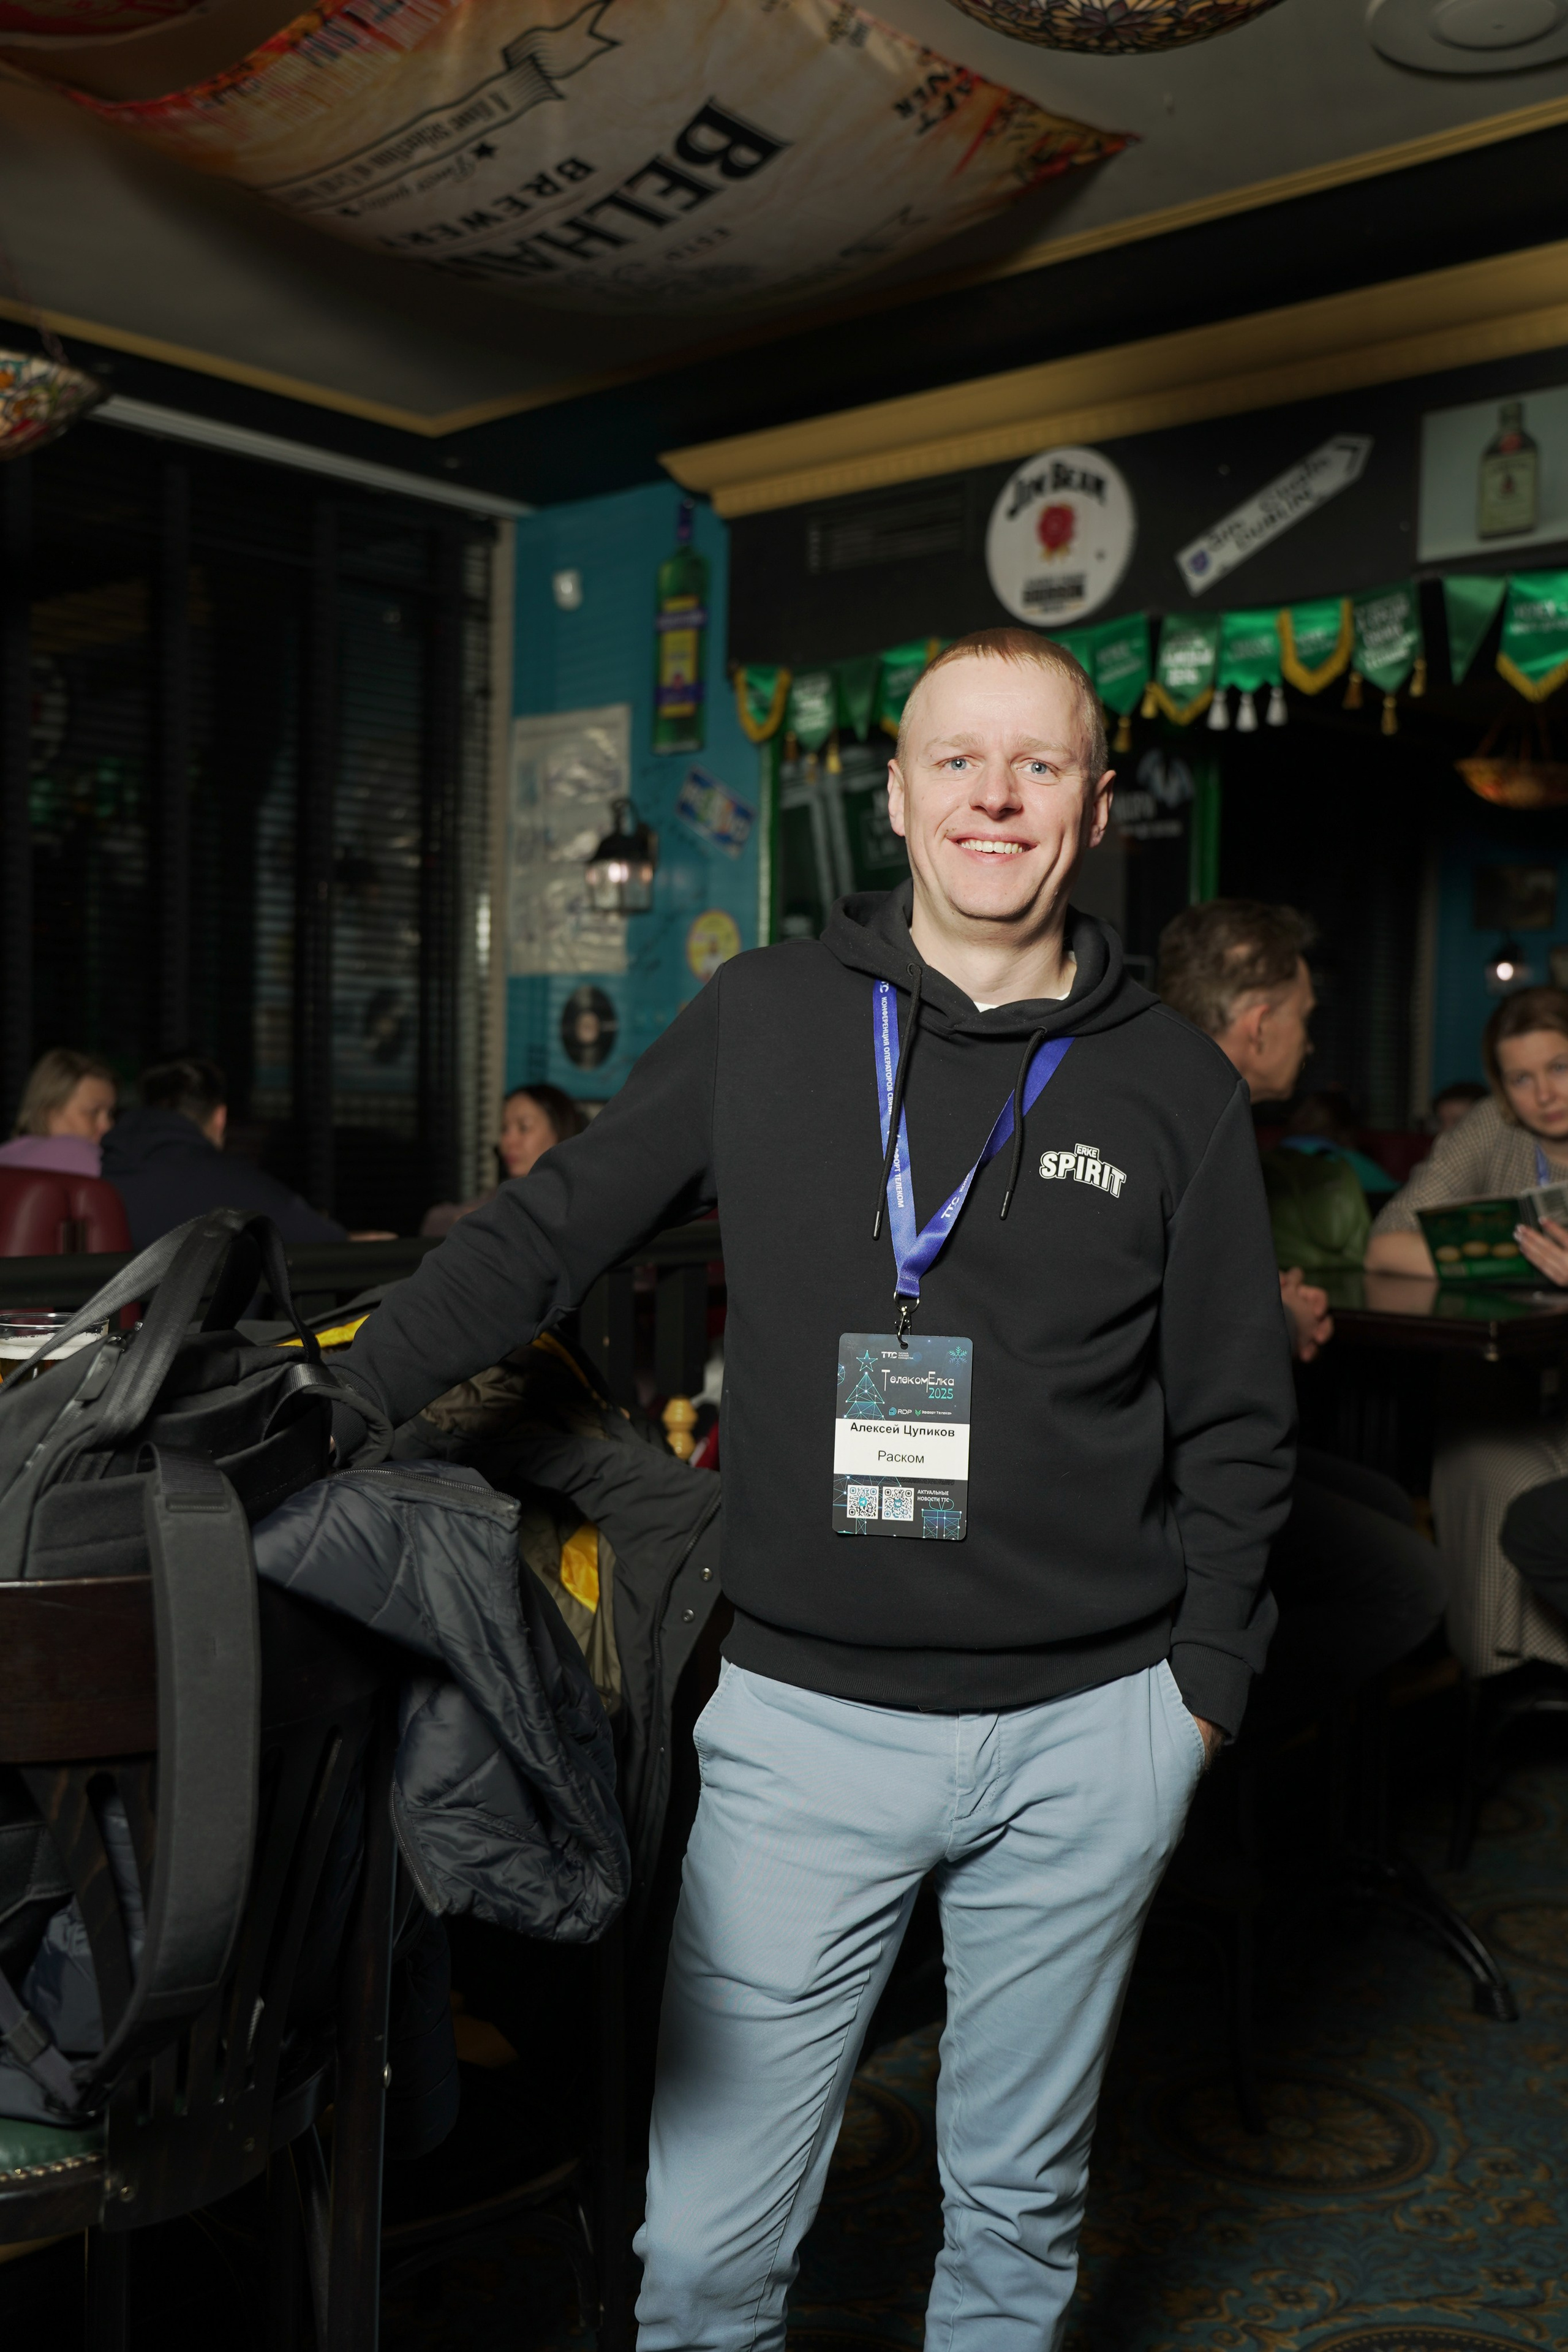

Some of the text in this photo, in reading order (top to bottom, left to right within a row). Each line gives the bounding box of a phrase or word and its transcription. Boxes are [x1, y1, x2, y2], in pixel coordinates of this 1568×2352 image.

[881, 997, 889, 1046] КОНФЕРЕНЦИЯ
[884, 1047, 893, 1092] ОПЕРАТОРОВ
[1076, 1145, 1098, 1159] ERKE
[1041, 1152, 1125, 1196] SPIRIT
[895, 1172, 904, 1208] ТЕЛЕКОМ
[927, 1387, 954, 1400] 2025
[850, 1422, 956, 1437] Алексей Цупиков
[878, 1450, 925, 1464] Раском
